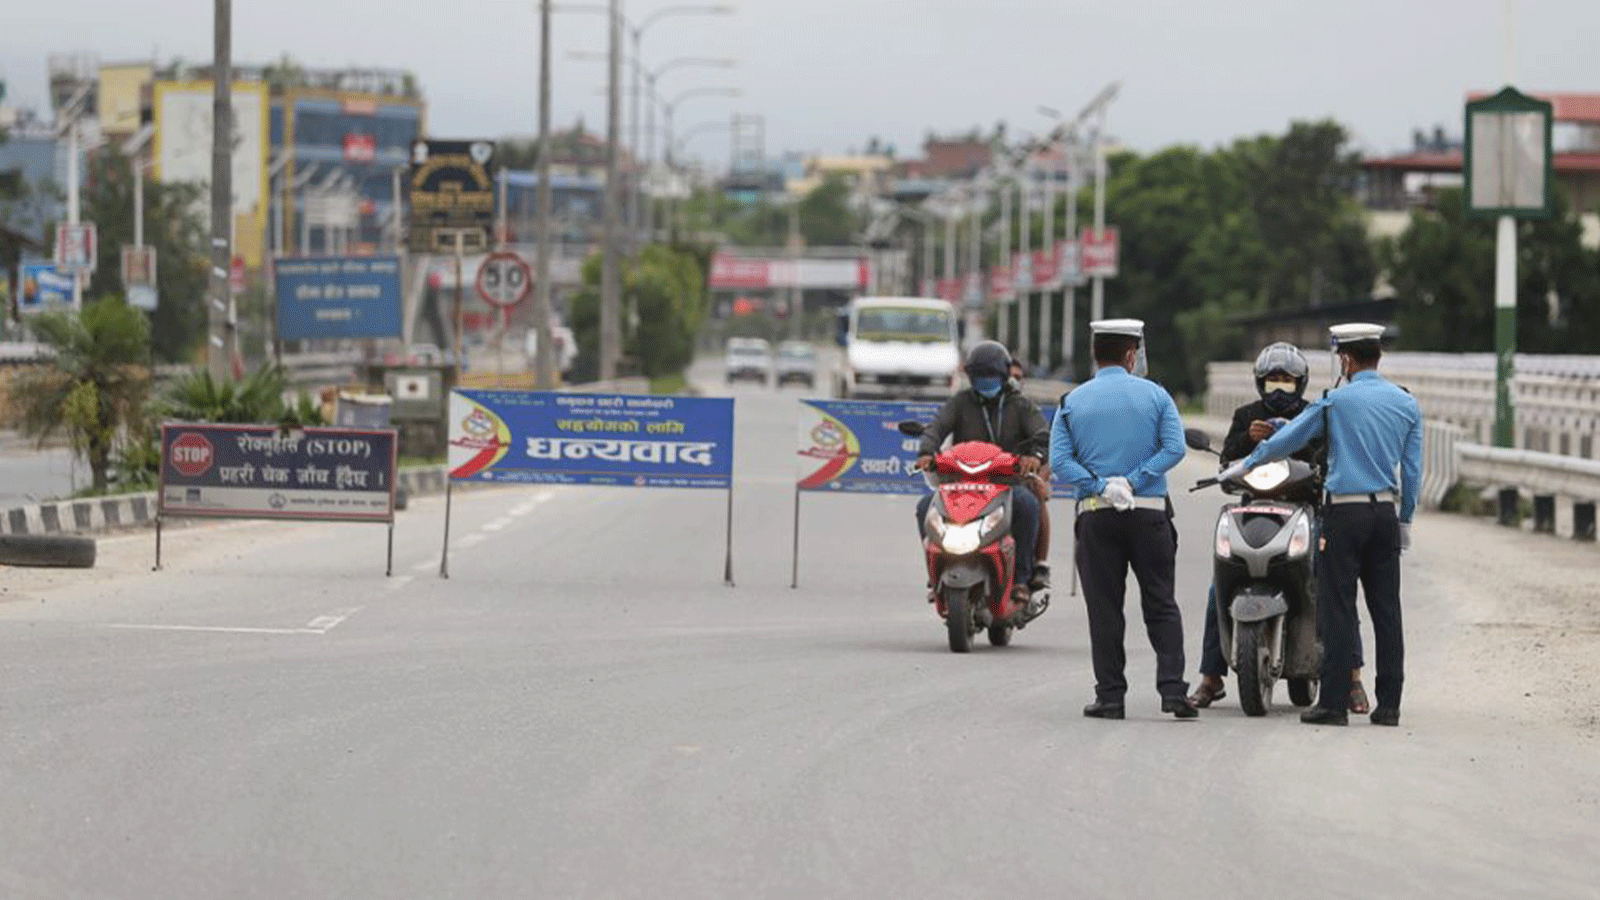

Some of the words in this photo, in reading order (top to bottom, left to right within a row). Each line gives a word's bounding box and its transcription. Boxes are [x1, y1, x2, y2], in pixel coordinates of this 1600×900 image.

[173, 446, 210, 463] STOP
[306, 437, 372, 457] (STOP)
[526, 437, 717, 466] धन्यवाद
[219, 462, 255, 484] प्रहरी
[262, 464, 290, 483] चेक
[861, 456, 900, 475] सवारी
